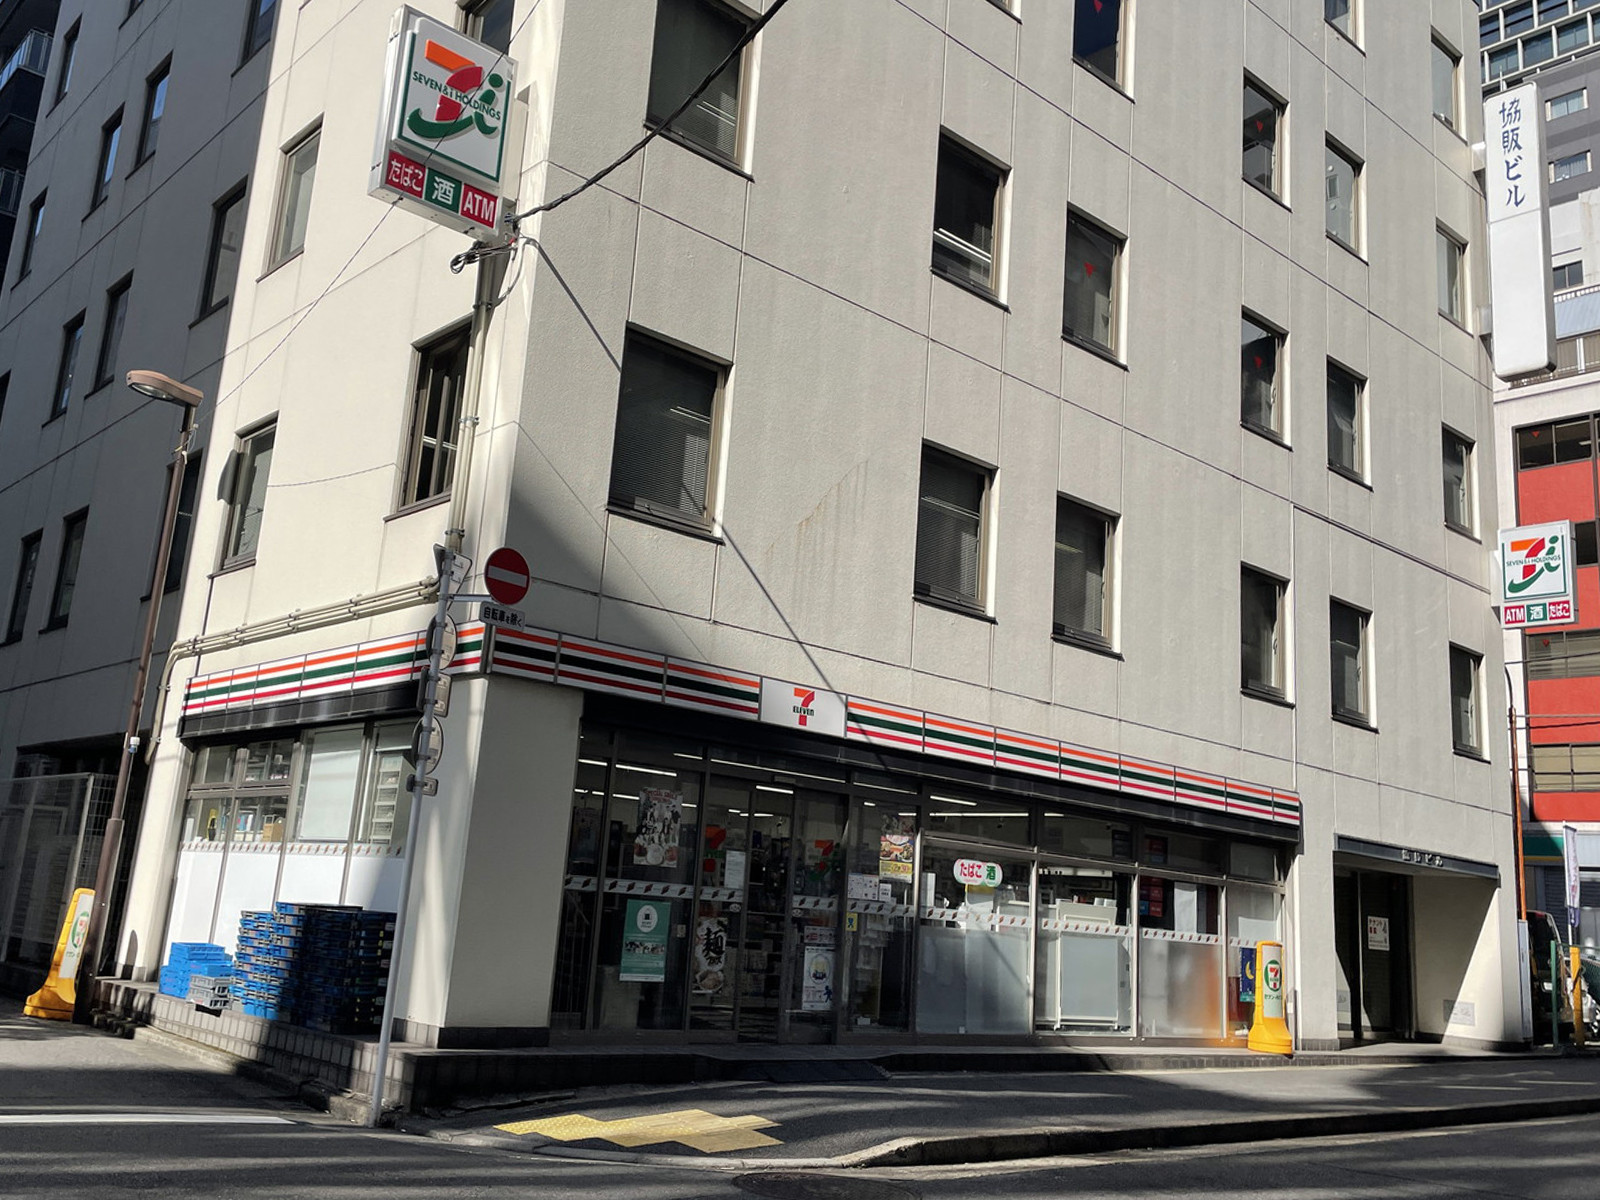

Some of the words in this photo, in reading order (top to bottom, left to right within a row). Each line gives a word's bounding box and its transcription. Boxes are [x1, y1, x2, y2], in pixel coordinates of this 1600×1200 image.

[455, 91, 501, 121] HOLDINGS
[1498, 97, 1526, 208] 協販ビル
[389, 158, 423, 191] たばこ
[433, 176, 455, 206] 酒
[464, 191, 496, 223] ATM
[484, 606, 522, 627] 自転車を除く
[1505, 608, 1524, 623] ATM
[1530, 606, 1543, 620] 酒
[1549, 604, 1569, 618] たばこ
[959, 862, 982, 878] たばこ
[986, 865, 996, 880] 酒
